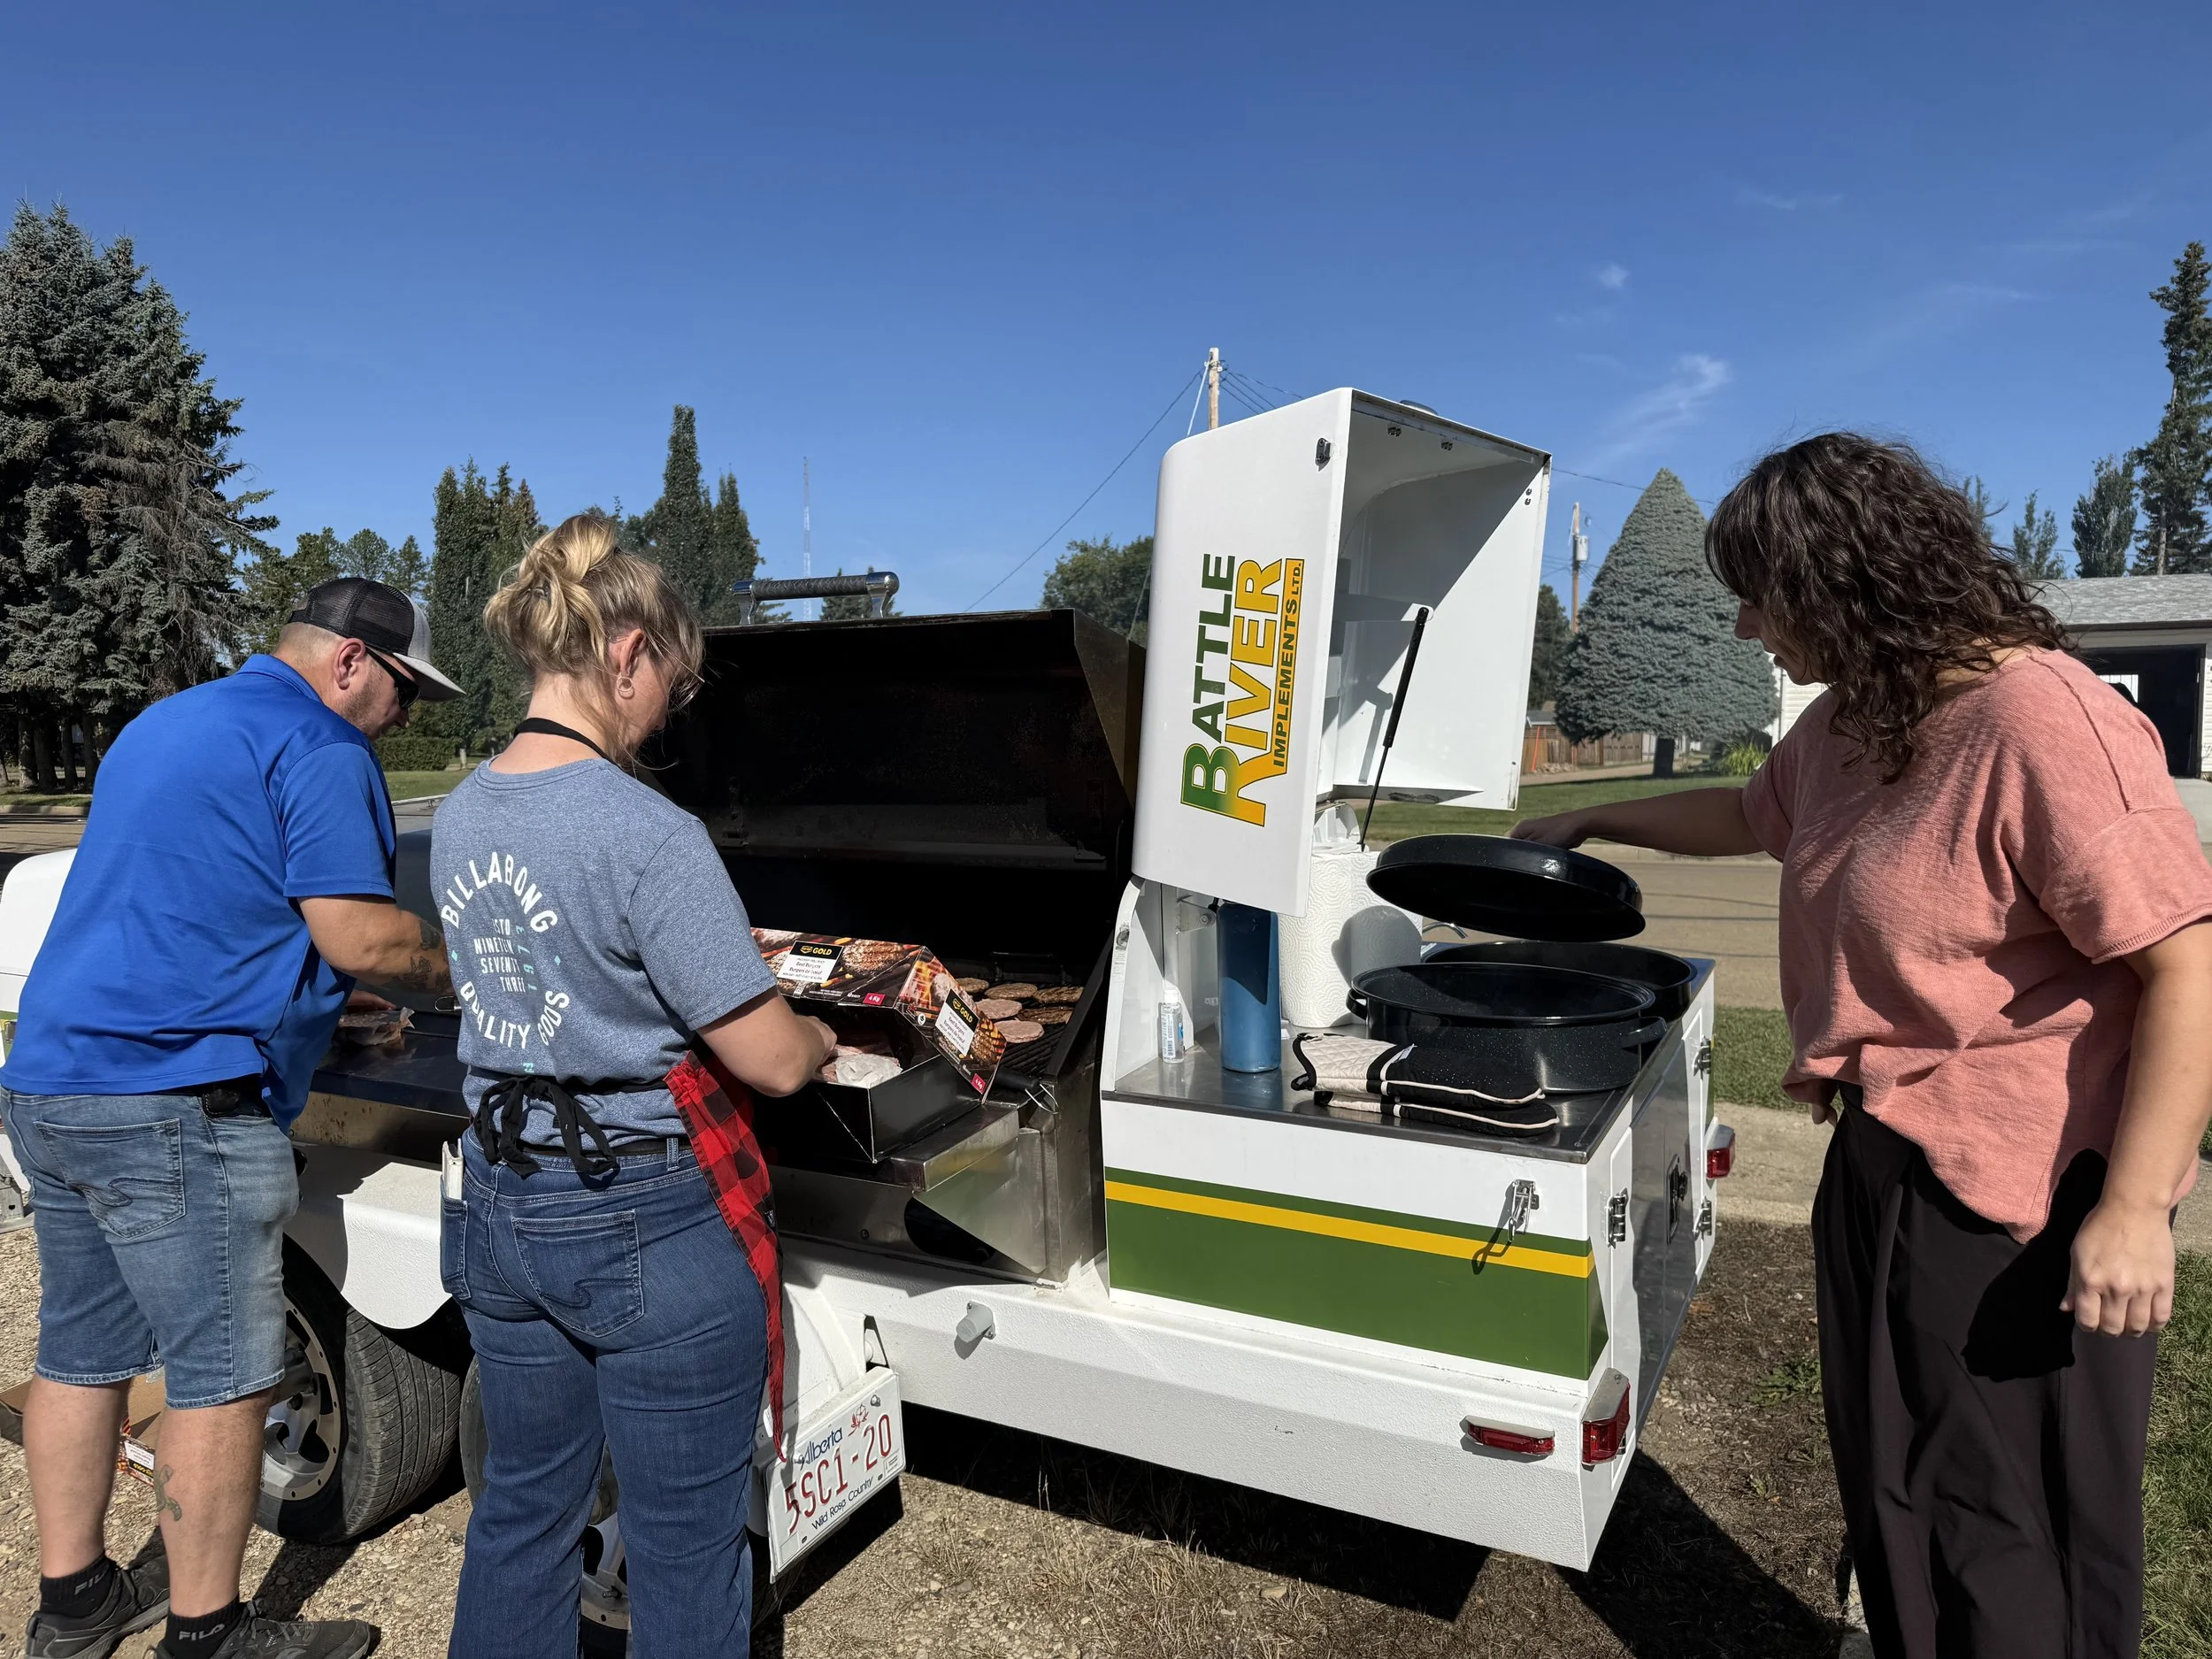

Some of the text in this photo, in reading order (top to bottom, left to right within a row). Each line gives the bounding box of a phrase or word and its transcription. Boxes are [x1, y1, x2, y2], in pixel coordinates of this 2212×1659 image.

[1180, 554, 1240, 819] BATTLE
[1225, 558, 1287, 826] RIVER
[1272, 562, 1302, 768] IMPLEMENTS LTD.
[442, 851, 558, 933] BILLABONG
[812, 947, 833, 956] GOLD
[460, 980, 531, 1049] QUALITY
[960, 1007, 973, 1024] GOLD
[800, 1426, 843, 1471] Alberta
[811, 1512, 828, 1530] Wild
[848, 1476, 874, 1502] Country
